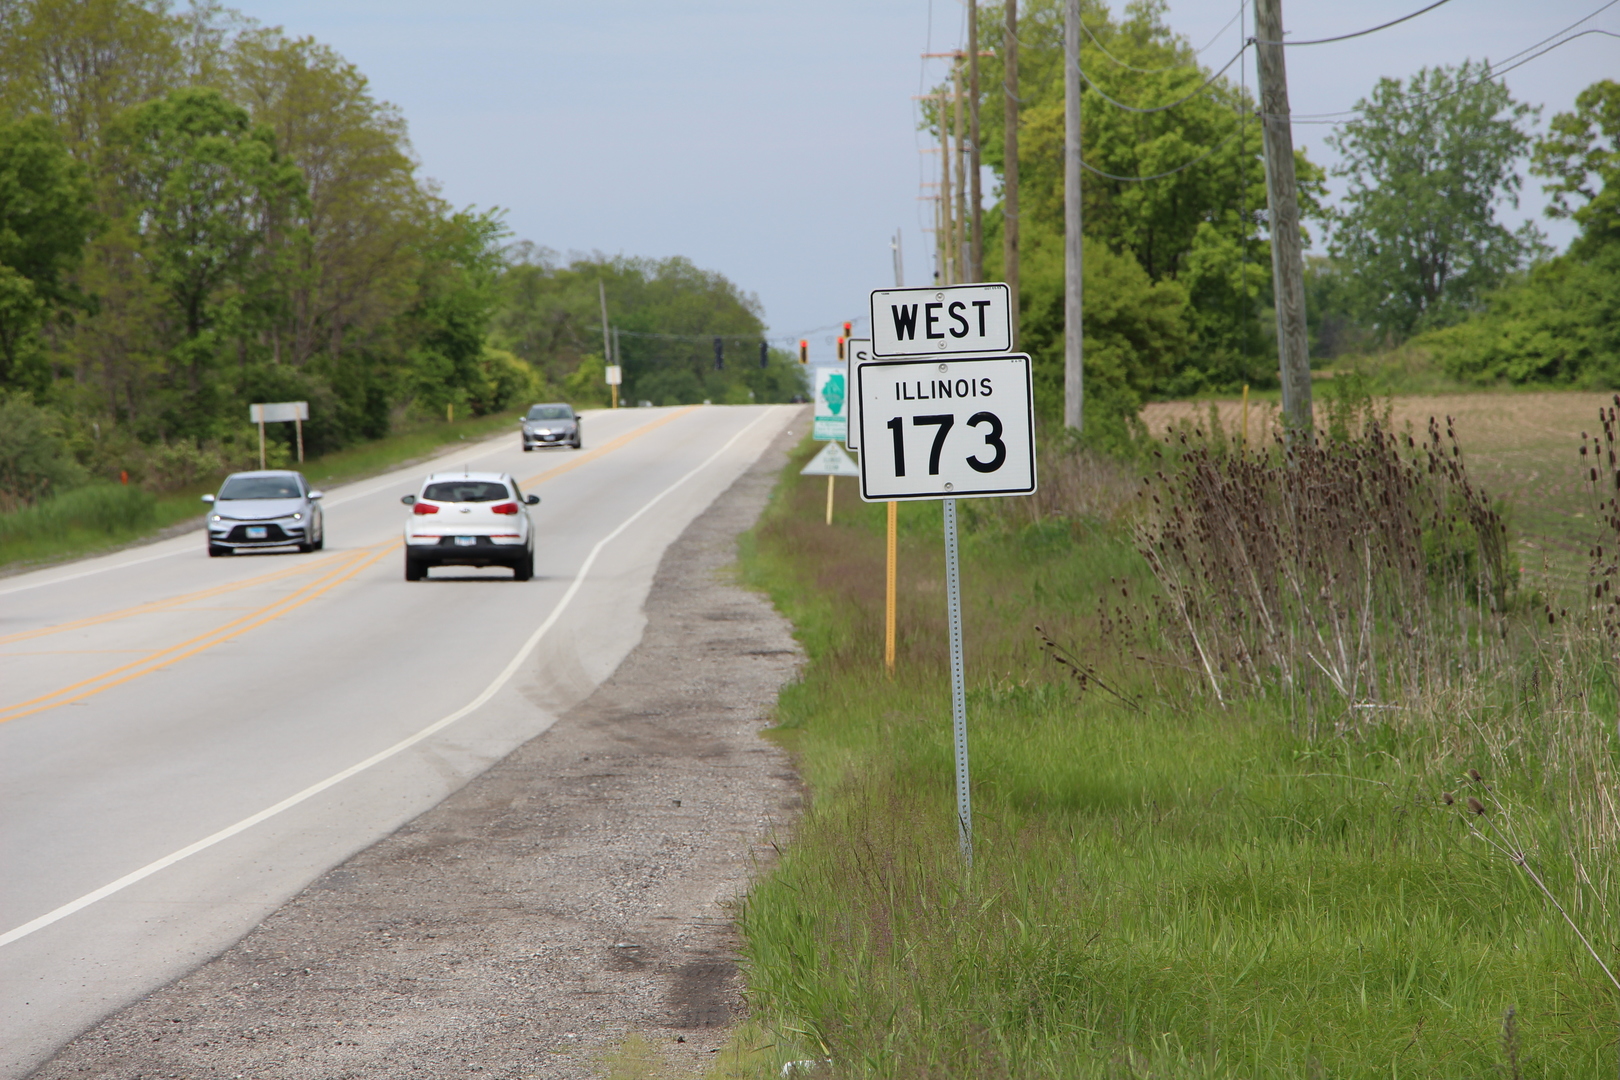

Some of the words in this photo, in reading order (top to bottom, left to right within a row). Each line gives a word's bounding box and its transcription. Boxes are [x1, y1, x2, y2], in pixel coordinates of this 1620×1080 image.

[892, 301, 990, 340] WEST
[896, 378, 992, 400] ILLINOIS
[887, 412, 1006, 477] 173
